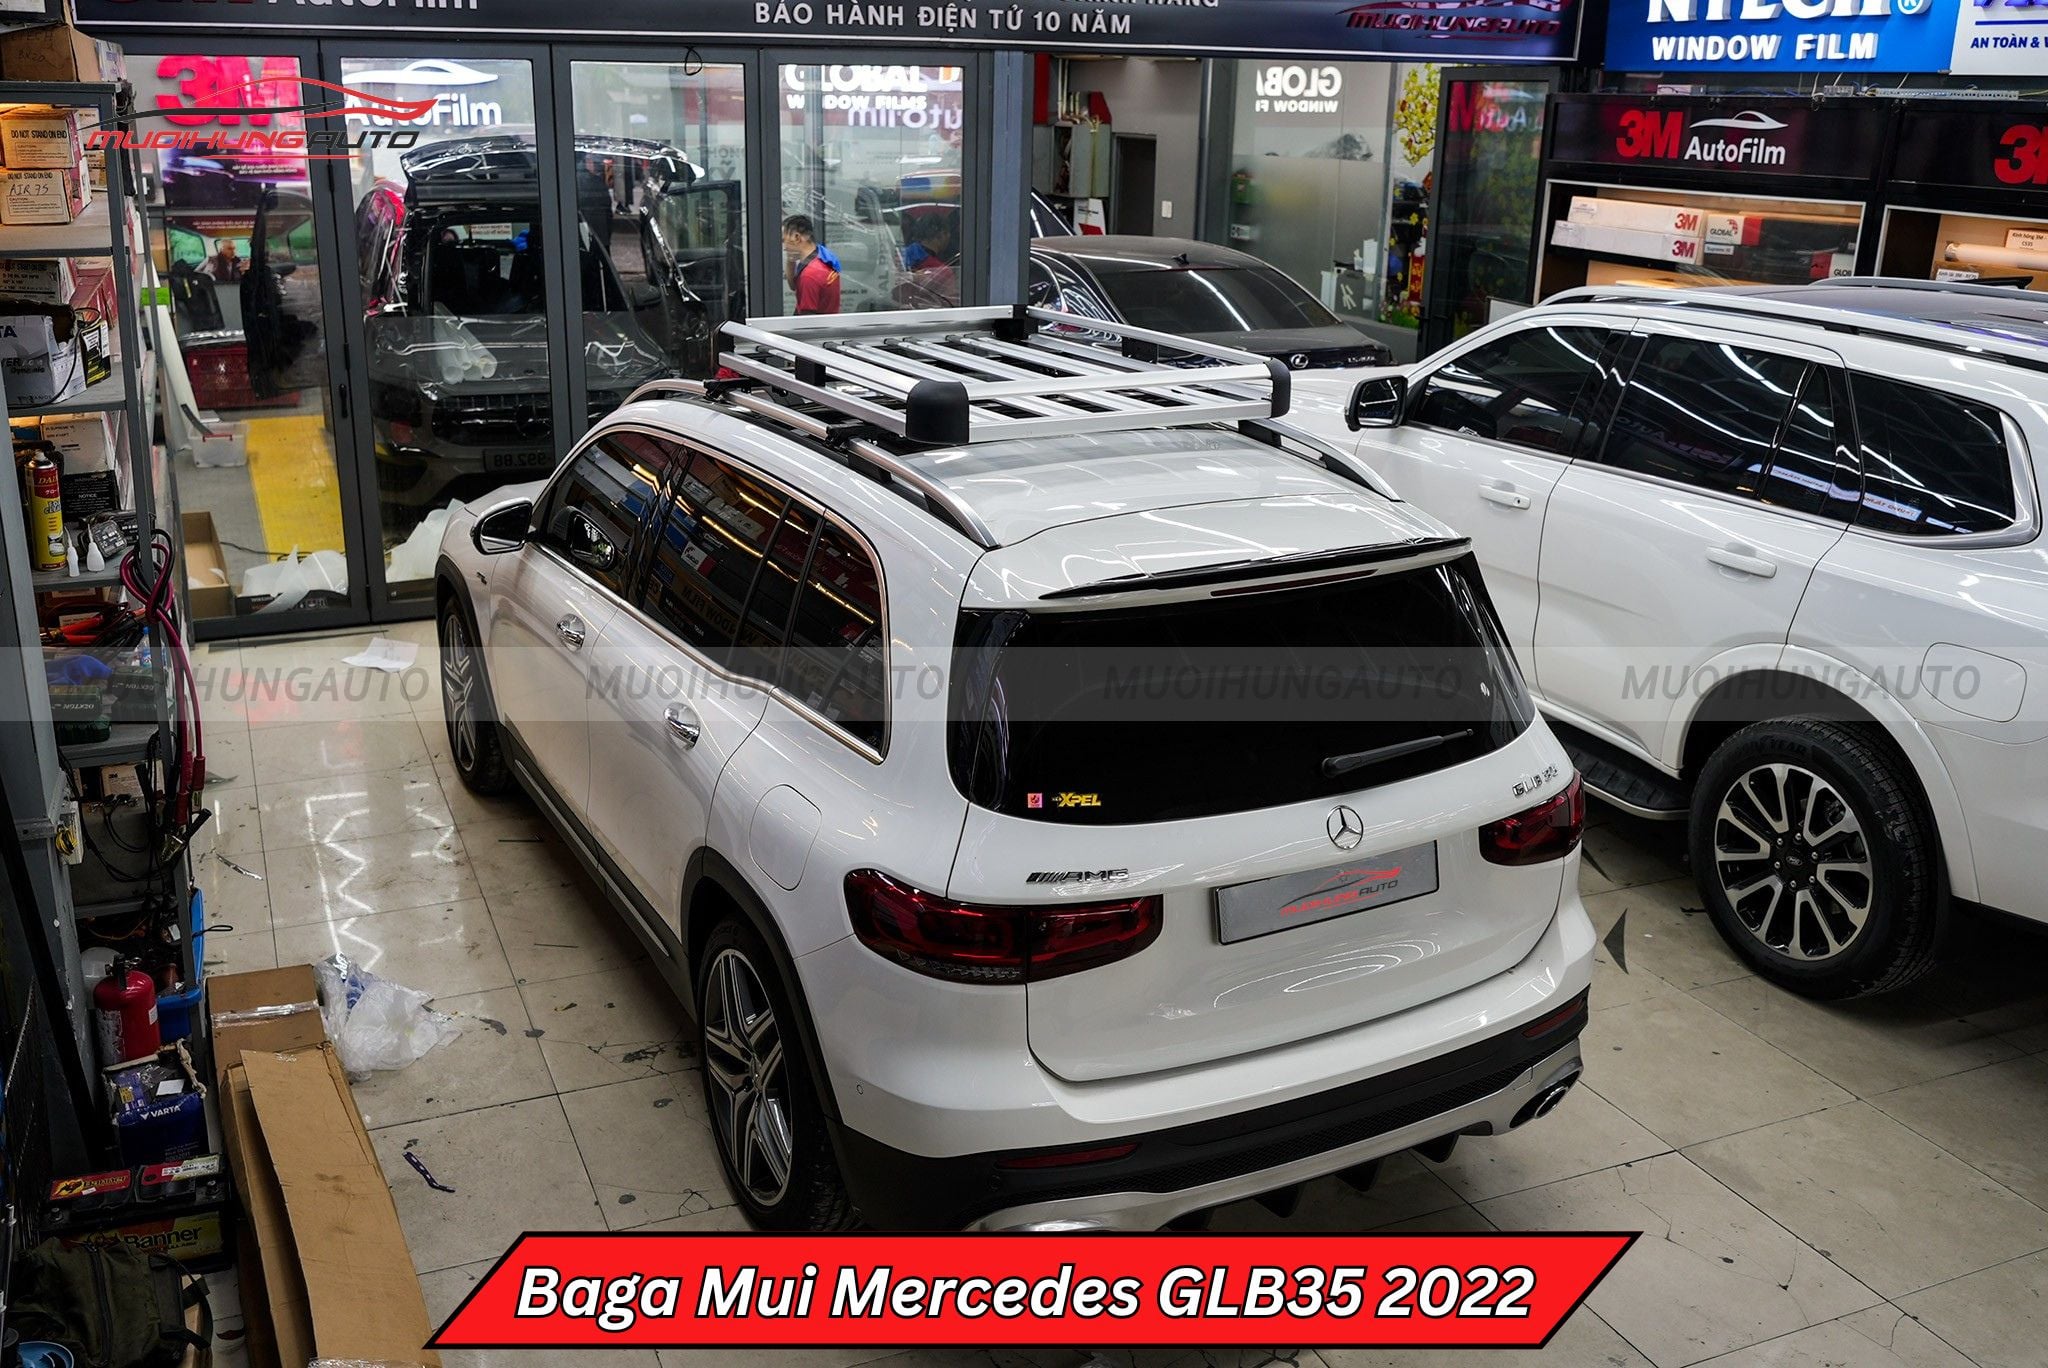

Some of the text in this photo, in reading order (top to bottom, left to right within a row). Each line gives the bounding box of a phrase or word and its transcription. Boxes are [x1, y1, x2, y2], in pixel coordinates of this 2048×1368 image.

[826, 0, 904, 27] HÀNH
[917, 3, 978, 33] ĐIỆN
[989, 4, 1025, 31] TỬ
[1033, 11, 1061, 33] 10
[1071, 8, 1131, 35] NĂM
[1651, 32, 1880, 61] WINDOW FILM
[1970, 37, 1989, 48] AN
[1992, 33, 2028, 48] TOÀN
[2031, 36, 2040, 48] &
[154, 54, 304, 128] 3M
[343, 92, 503, 127] AutoFilm
[11, 129, 68, 139] DO NOT STAND ON END
[1615, 110, 1684, 159] 3M
[1684, 136, 1786, 165] AutoFilm
[1674, 213, 1699, 232] 3M
[1709, 228, 1733, 237] GLOBAL
[1671, 240, 1696, 259] 3M
[1512, 774, 1542, 798] GLB
[1058, 792, 1102, 807] XPEL
[150, 1105, 182, 1119] VARTA
[123, 1226, 202, 1249] Banner
